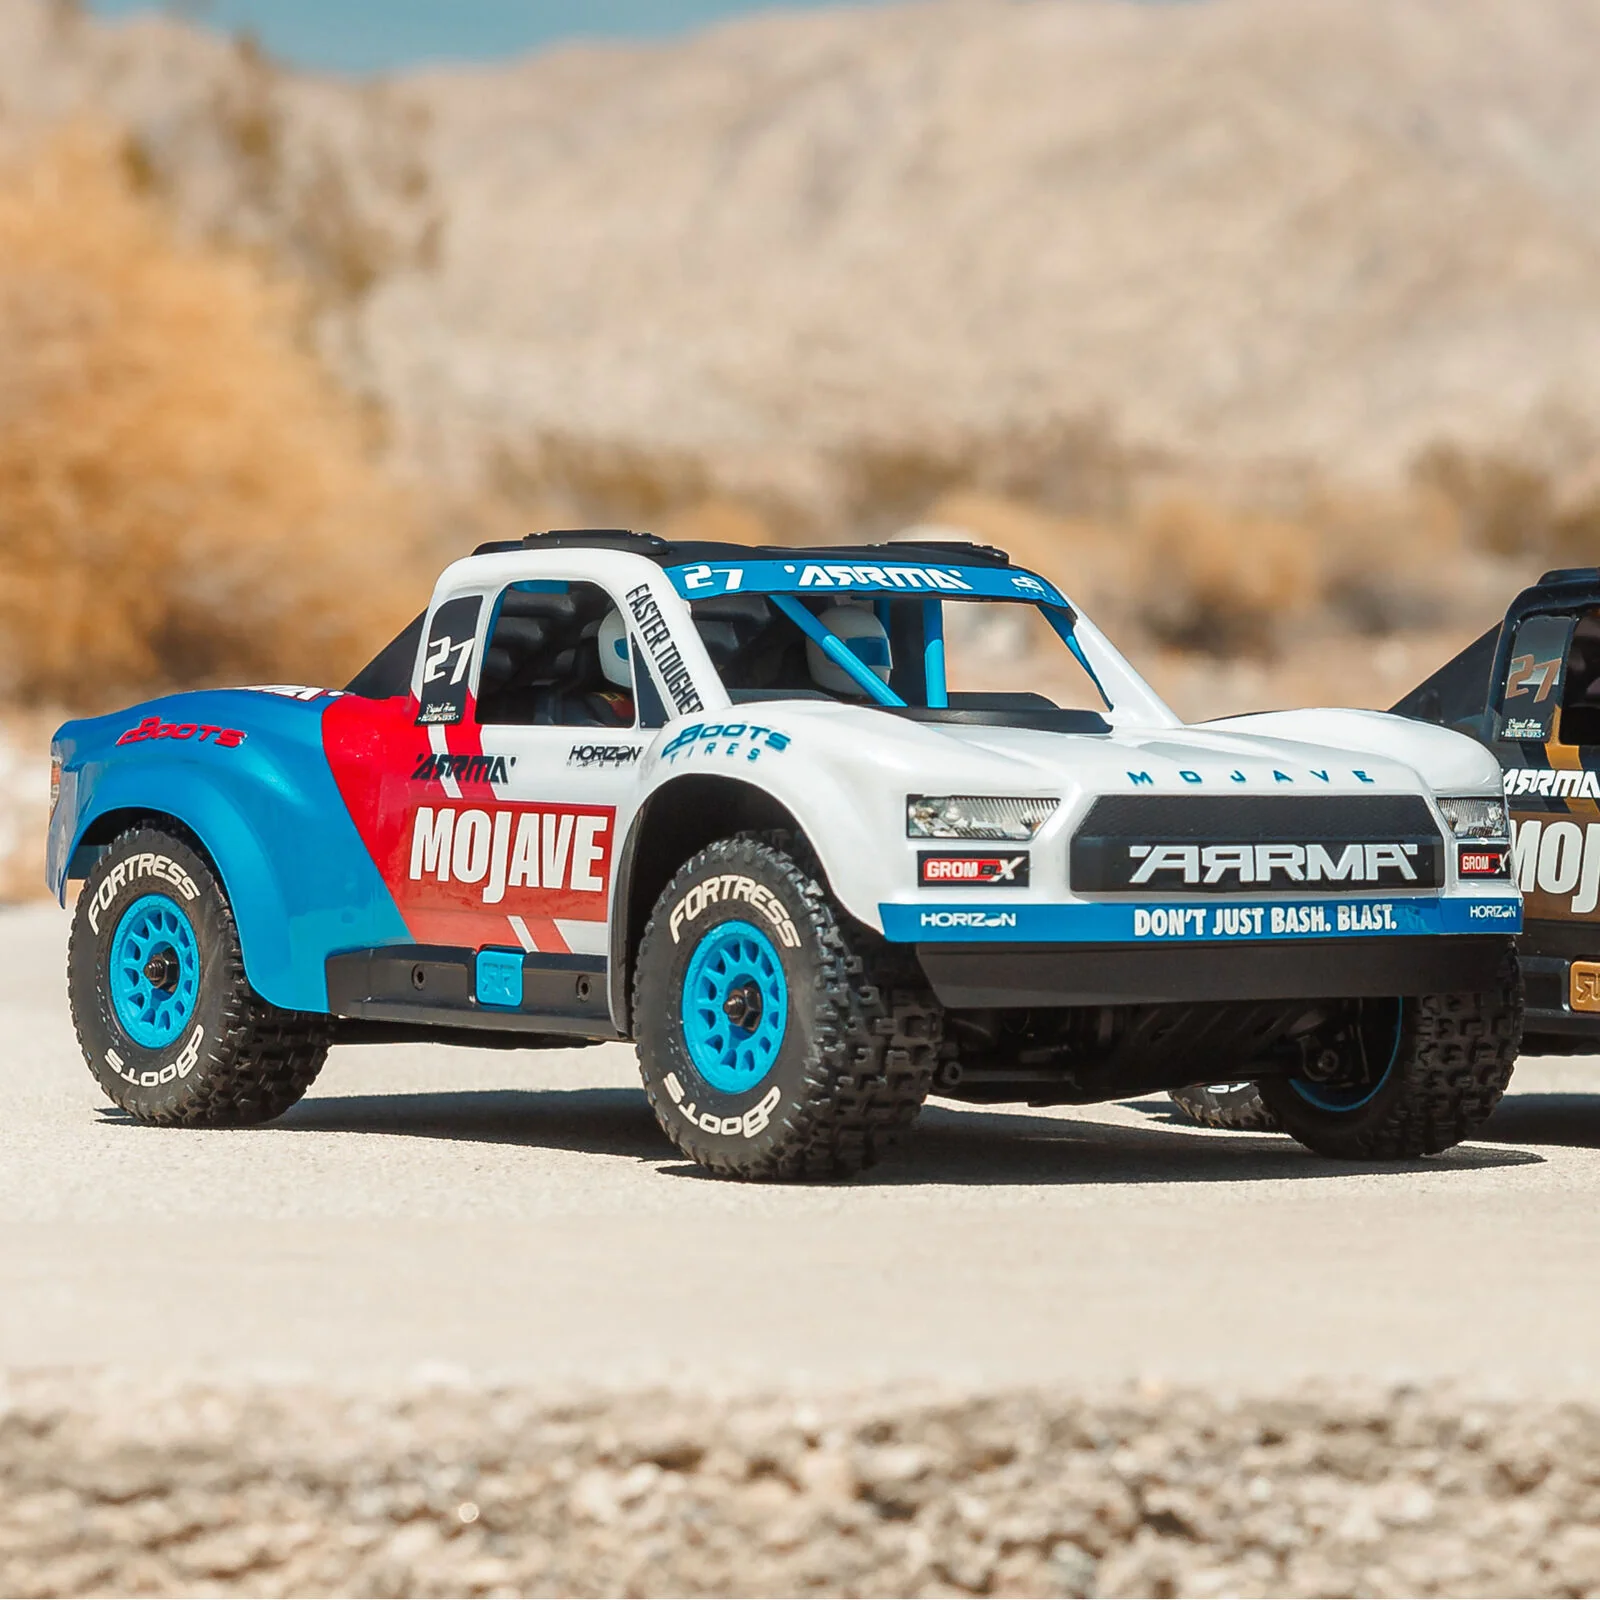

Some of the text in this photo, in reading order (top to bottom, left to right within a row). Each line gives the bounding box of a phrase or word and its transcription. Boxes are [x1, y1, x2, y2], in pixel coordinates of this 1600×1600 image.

[682, 565, 743, 590] 27
[424, 636, 475, 685] 27
[1505, 654, 1562, 703] 27
[115, 715, 247, 748] BOOTS
[661, 723, 791, 758] BOOTS
[568, 745, 643, 761] HORIZON
[670, 742, 760, 764] TIRES
[1127, 770, 1375, 785] MOJAVE
[409, 806, 609, 904] MOJAVE
[88, 852, 201, 935] FORTRESS
[670, 875, 801, 947] FORTRESS
[920, 912, 1017, 927] HORIZON
[1134, 904, 1397, 936] DON'T JUST BASH. BLAST.
[1470, 904, 1516, 918] HORIZON
[104, 1024, 204, 1087] BOOTS
[663, 1072, 781, 1138] BOOTS
